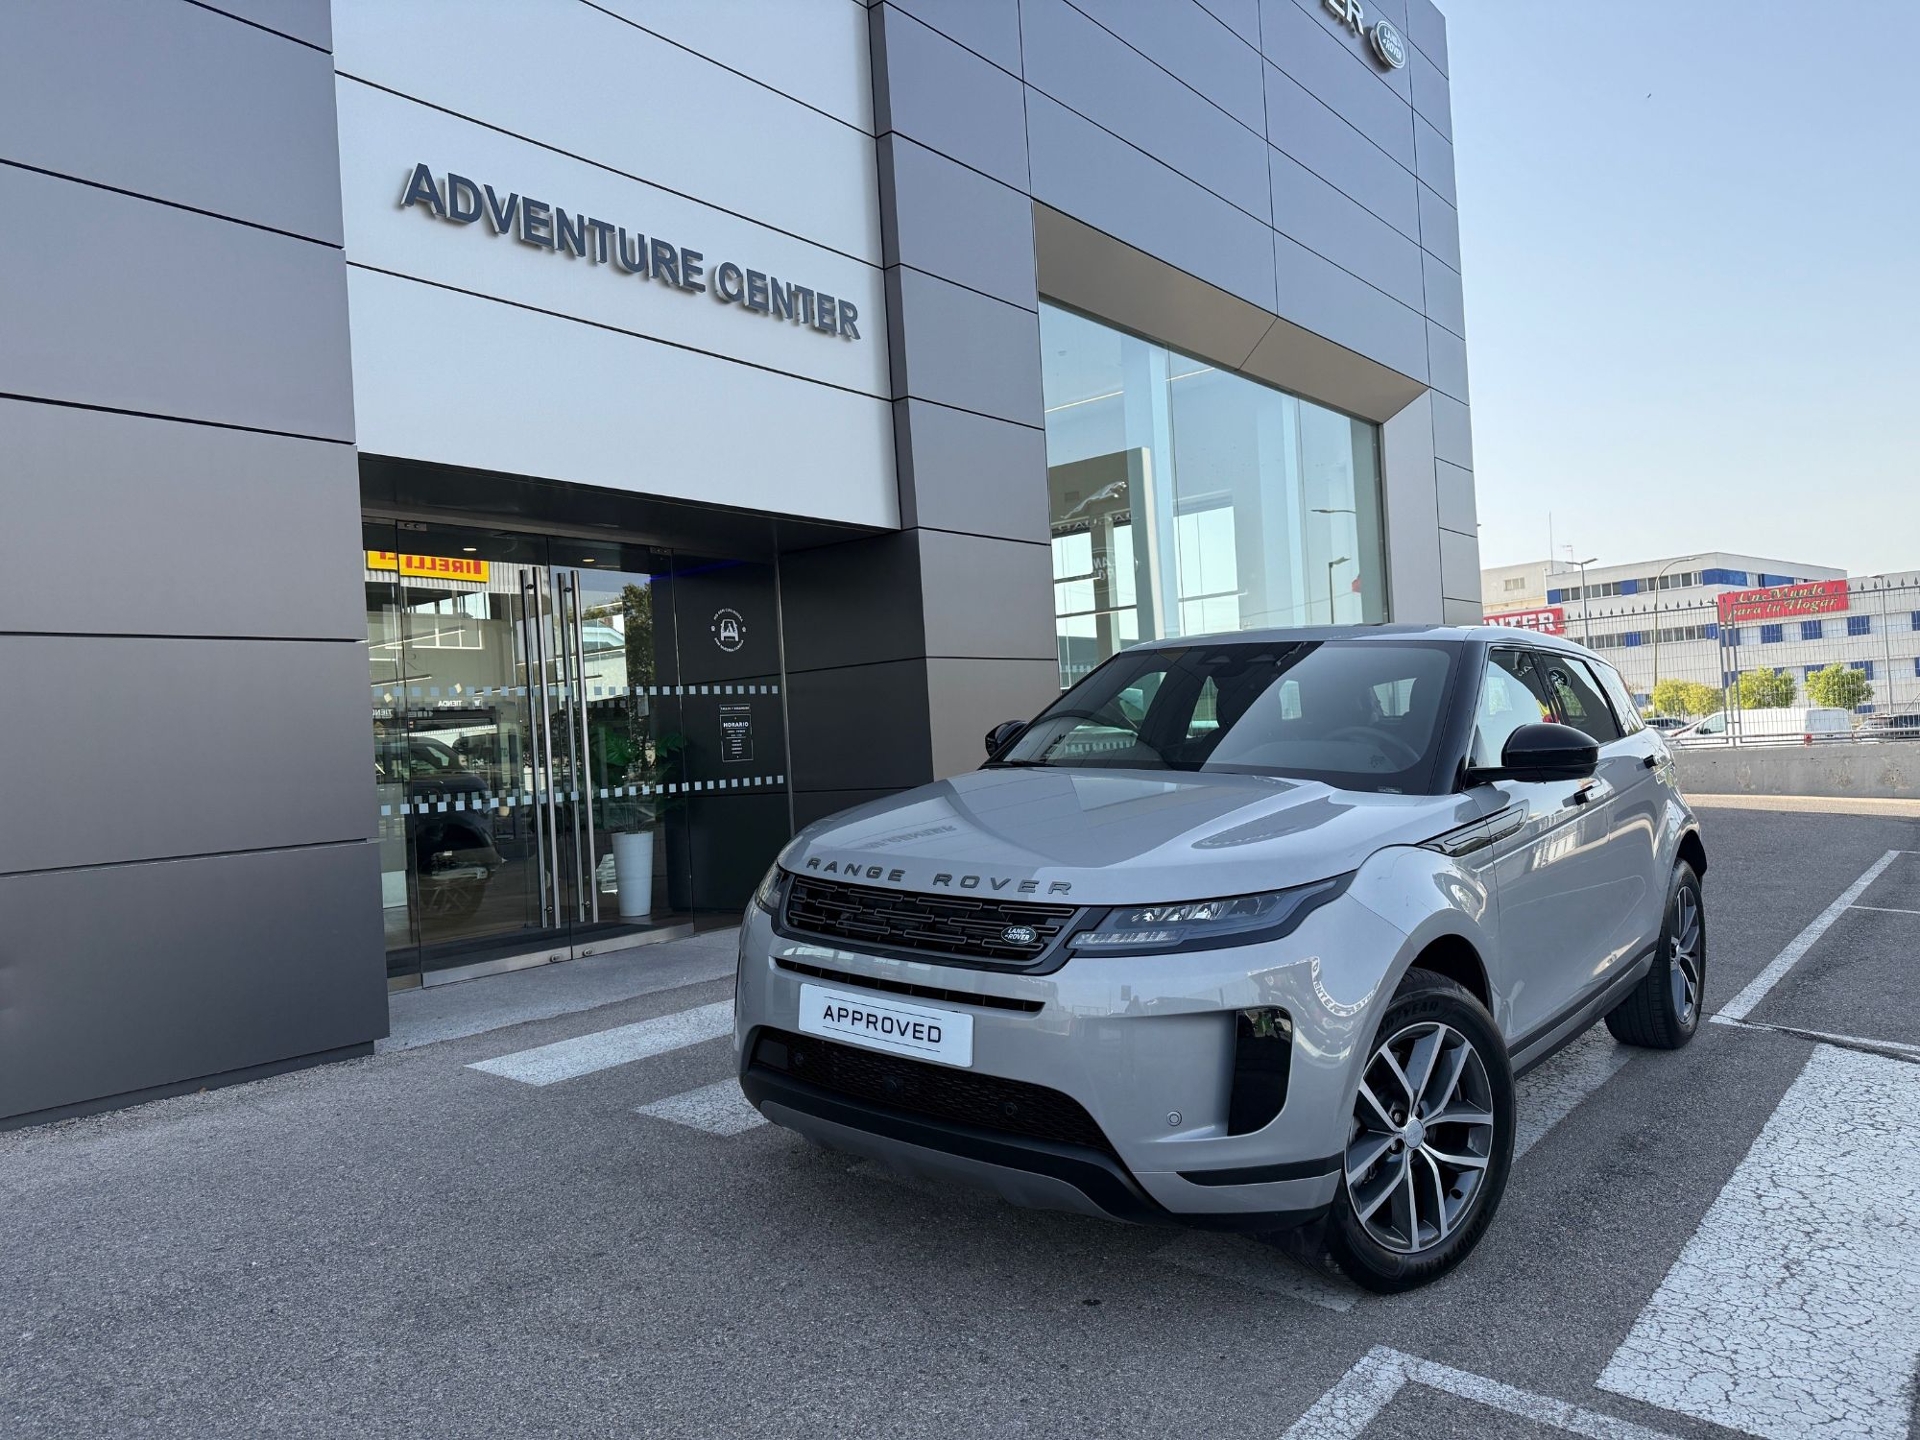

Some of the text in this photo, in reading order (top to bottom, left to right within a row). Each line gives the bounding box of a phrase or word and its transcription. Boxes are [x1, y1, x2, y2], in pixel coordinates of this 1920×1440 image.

[401, 162, 862, 340] ADVENTURE CENTER
[1484, 612, 1556, 632] NTER
[806, 857, 1072, 896] RANGE ROVER
[1008, 933, 1031, 941] ROVER
[823, 1004, 942, 1043] APPROVED
